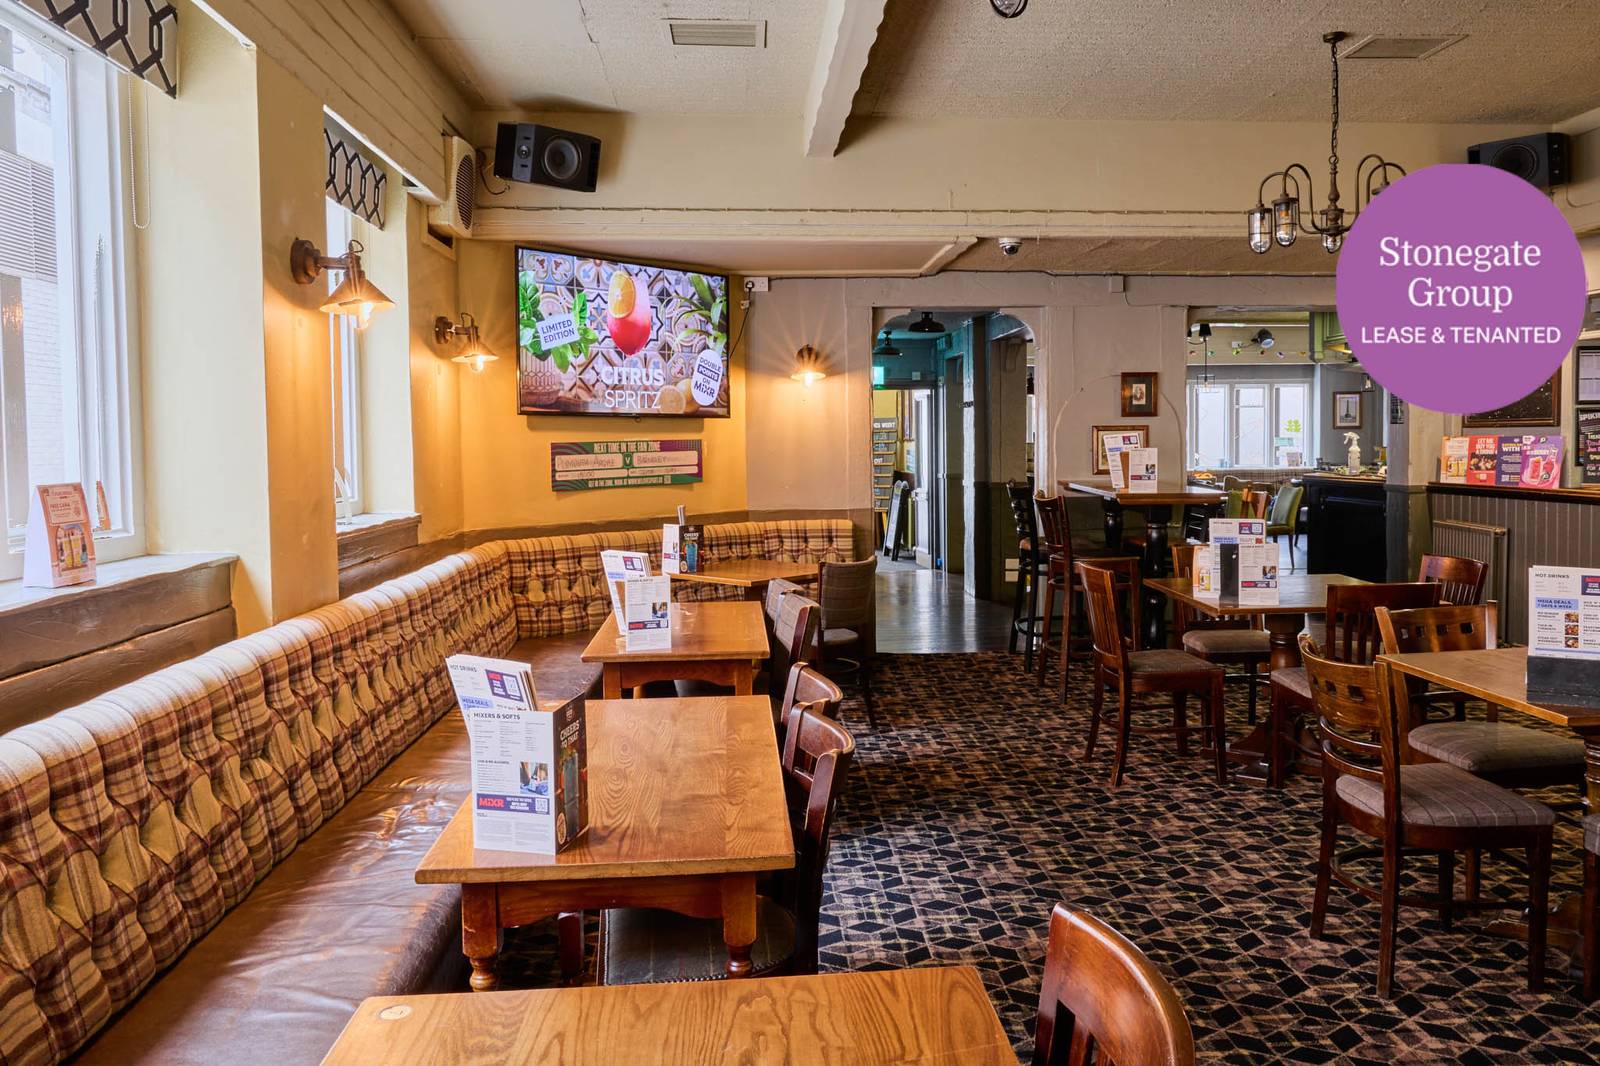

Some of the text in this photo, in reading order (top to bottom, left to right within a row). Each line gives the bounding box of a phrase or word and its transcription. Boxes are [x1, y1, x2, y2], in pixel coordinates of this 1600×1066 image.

[541, 319, 573, 334] LIMITED
[543, 329, 575, 344] EDITION
[699, 357, 721, 372] DOUBLE
[599, 366, 665, 386] CITRUS
[702, 377, 710, 385] ON
[604, 390, 662, 410] SPRITZ
[560, 720, 580, 741] CHEERS
